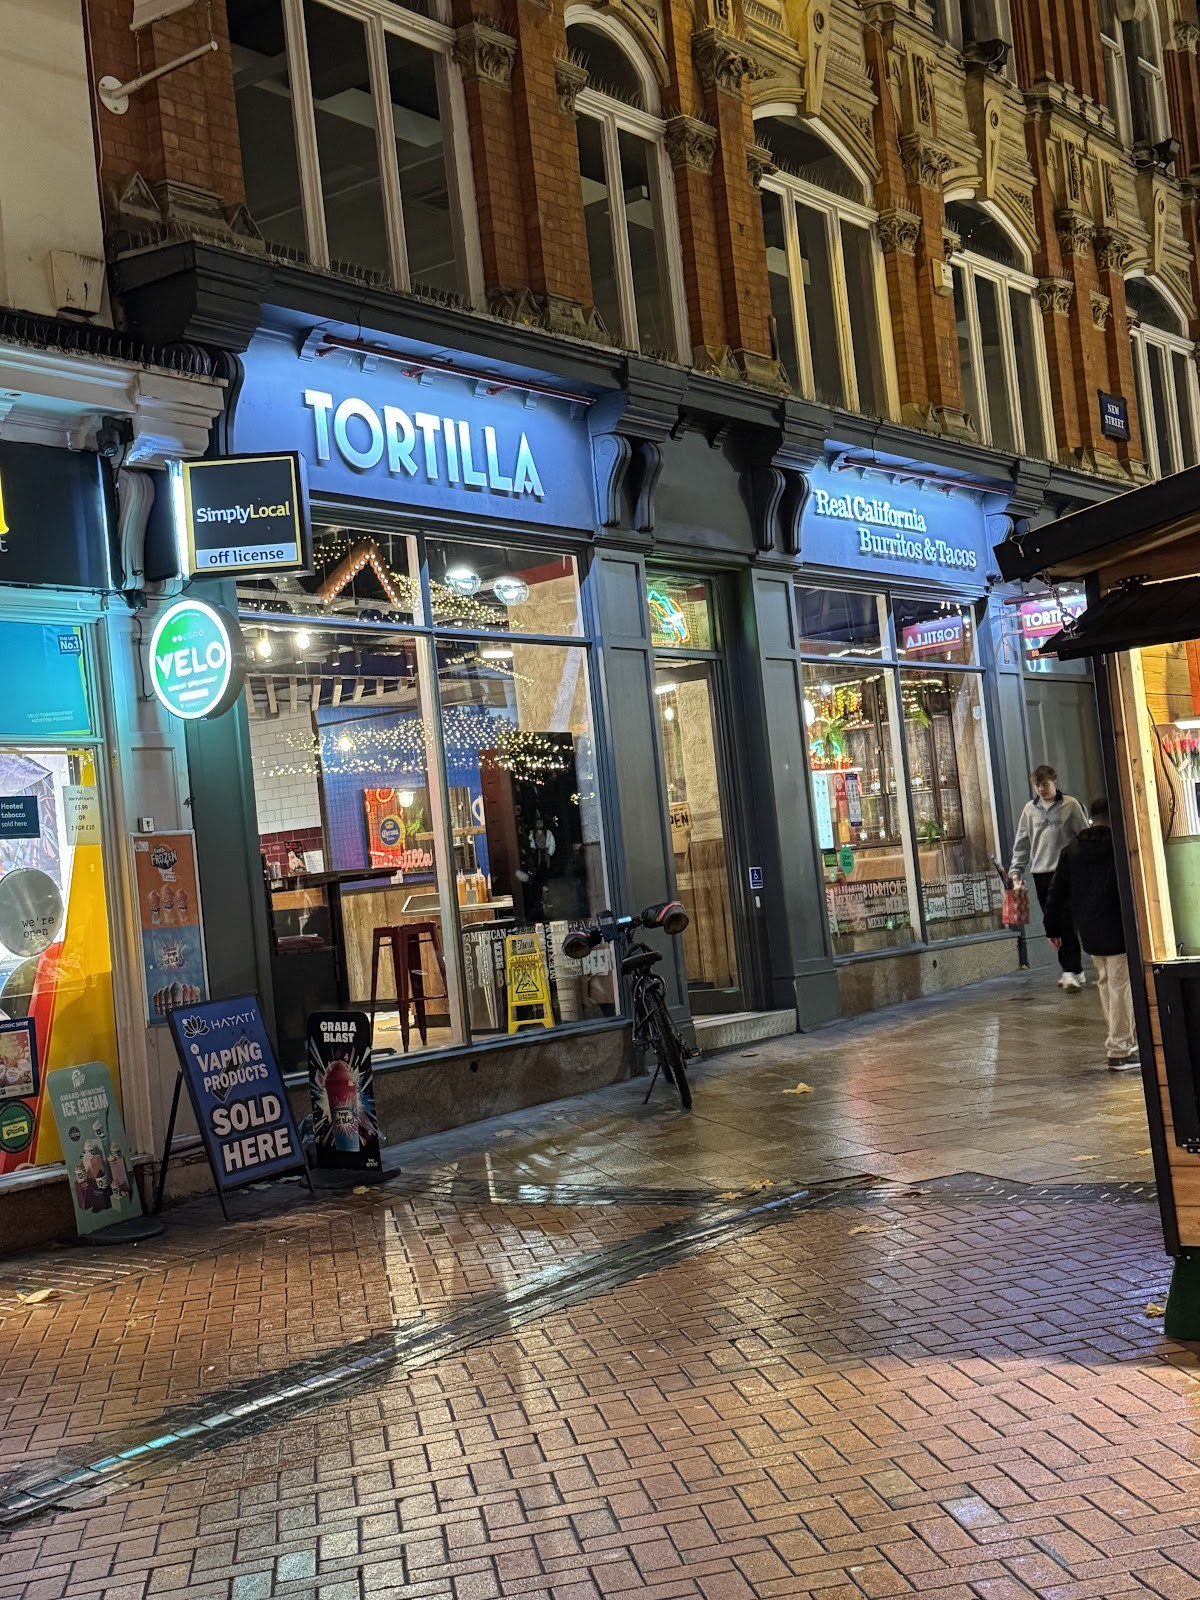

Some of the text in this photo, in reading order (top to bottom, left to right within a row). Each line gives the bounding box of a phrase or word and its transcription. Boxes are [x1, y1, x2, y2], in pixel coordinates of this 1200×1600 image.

[1107, 403, 1120, 416] NEW
[1104, 415, 1125, 429] STREET
[304, 388, 545, 498] TORTILLA
[196, 500, 291, 525] SimplyLocal
[815, 489, 927, 533] Real California
[209, 549, 284, 564] off license
[858, 526, 977, 568] Burritos & Tacos
[60, 640, 79, 650] No.1
[155, 640, 226, 680] VELO
[150, 849, 178, 867] FROZEN
[22, 916, 55, 928] we're
[23, 928, 49, 940] open
[210, 1011, 256, 1031] HAYATI
[320, 1021, 349, 1032] GRAB
[323, 1032, 355, 1043] BLAST
[195, 1041, 263, 1073] VAPING
[203, 1063, 269, 1093] PRODUCTS
[61, 1092, 109, 1118] ICE CREAM
[212, 1094, 282, 1136] SOLD
[222, 1127, 292, 1173] HERE
